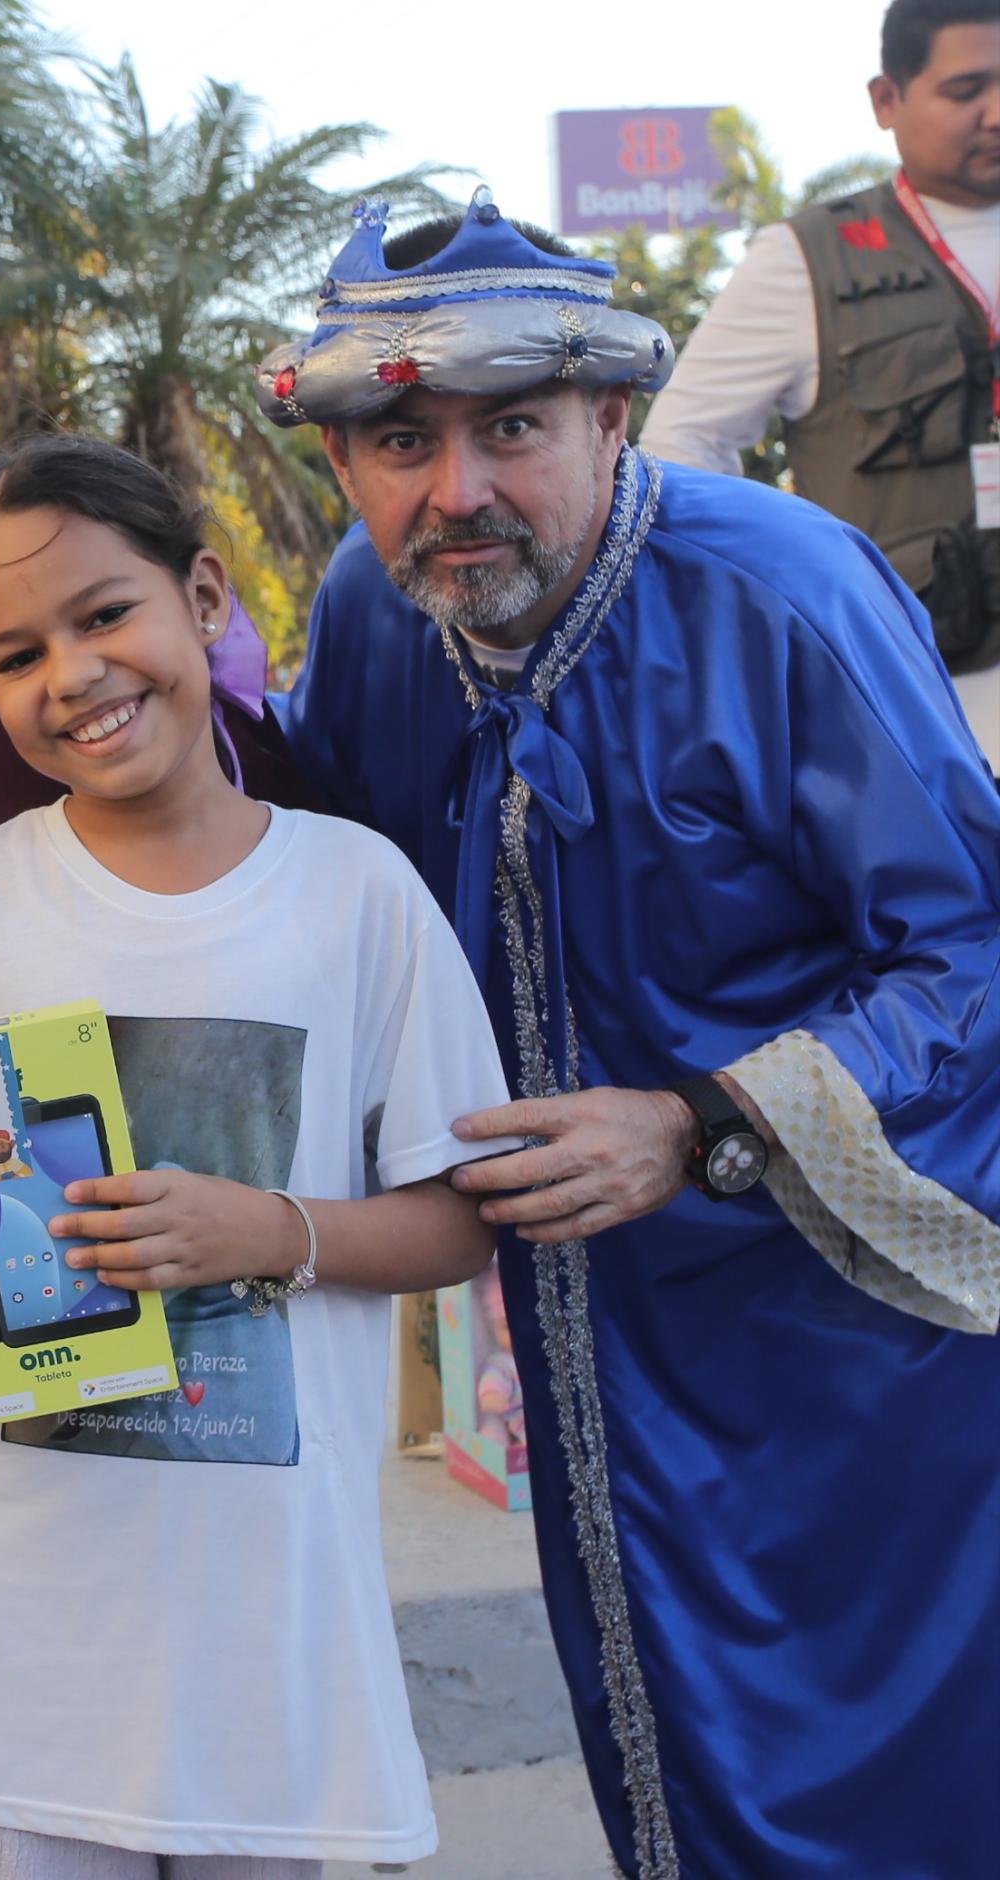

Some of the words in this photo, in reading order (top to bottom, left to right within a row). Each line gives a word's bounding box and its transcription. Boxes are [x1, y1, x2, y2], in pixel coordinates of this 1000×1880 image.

[19, 1346, 82, 1371] onn.
[191, 1351, 248, 1373] Peraza
[34, 1370, 72, 1383] Tableta
[57, 1411, 168, 1434] Desaparecido
[173, 1412, 257, 1441] 12/jun/21
